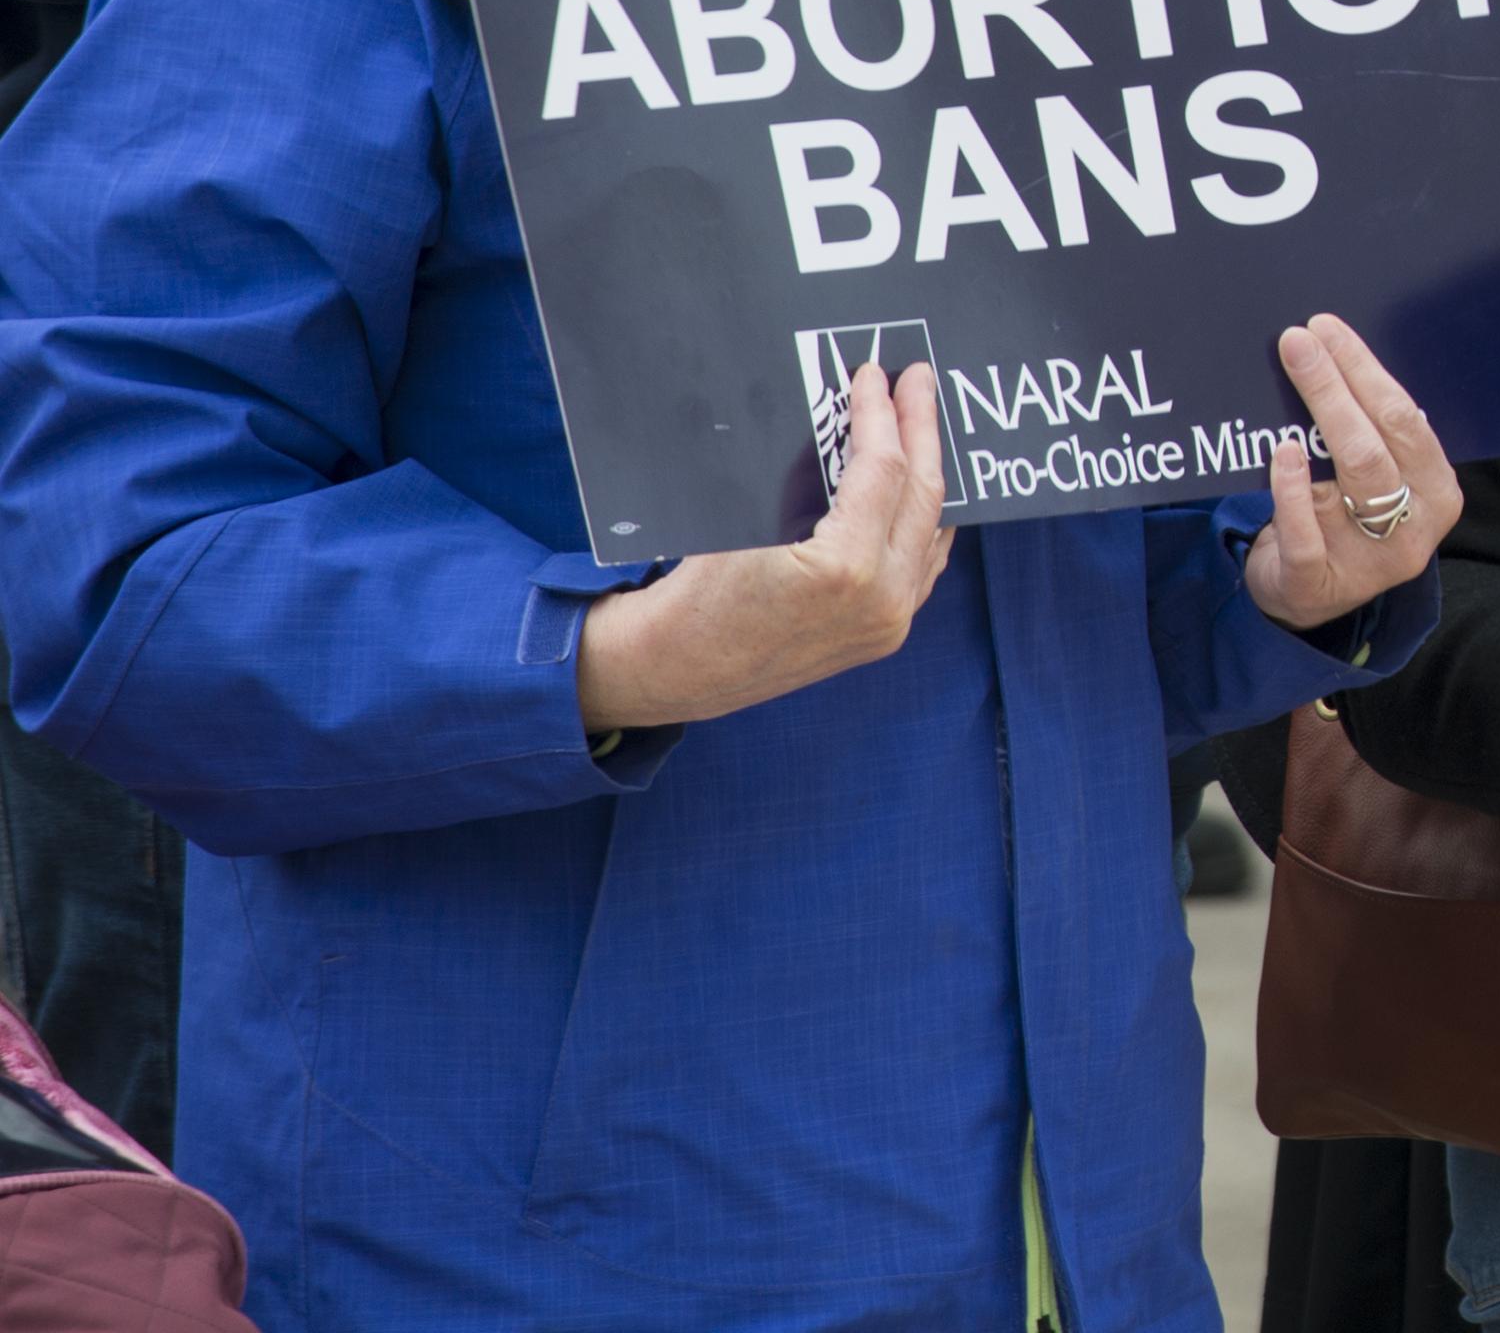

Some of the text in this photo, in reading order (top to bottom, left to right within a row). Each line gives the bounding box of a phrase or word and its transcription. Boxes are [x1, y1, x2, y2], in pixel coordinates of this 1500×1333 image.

[769, 68, 1321, 276] BANS
[946, 350, 1174, 436] NARAL
[967, 438, 1187, 503] Pro-Choice
